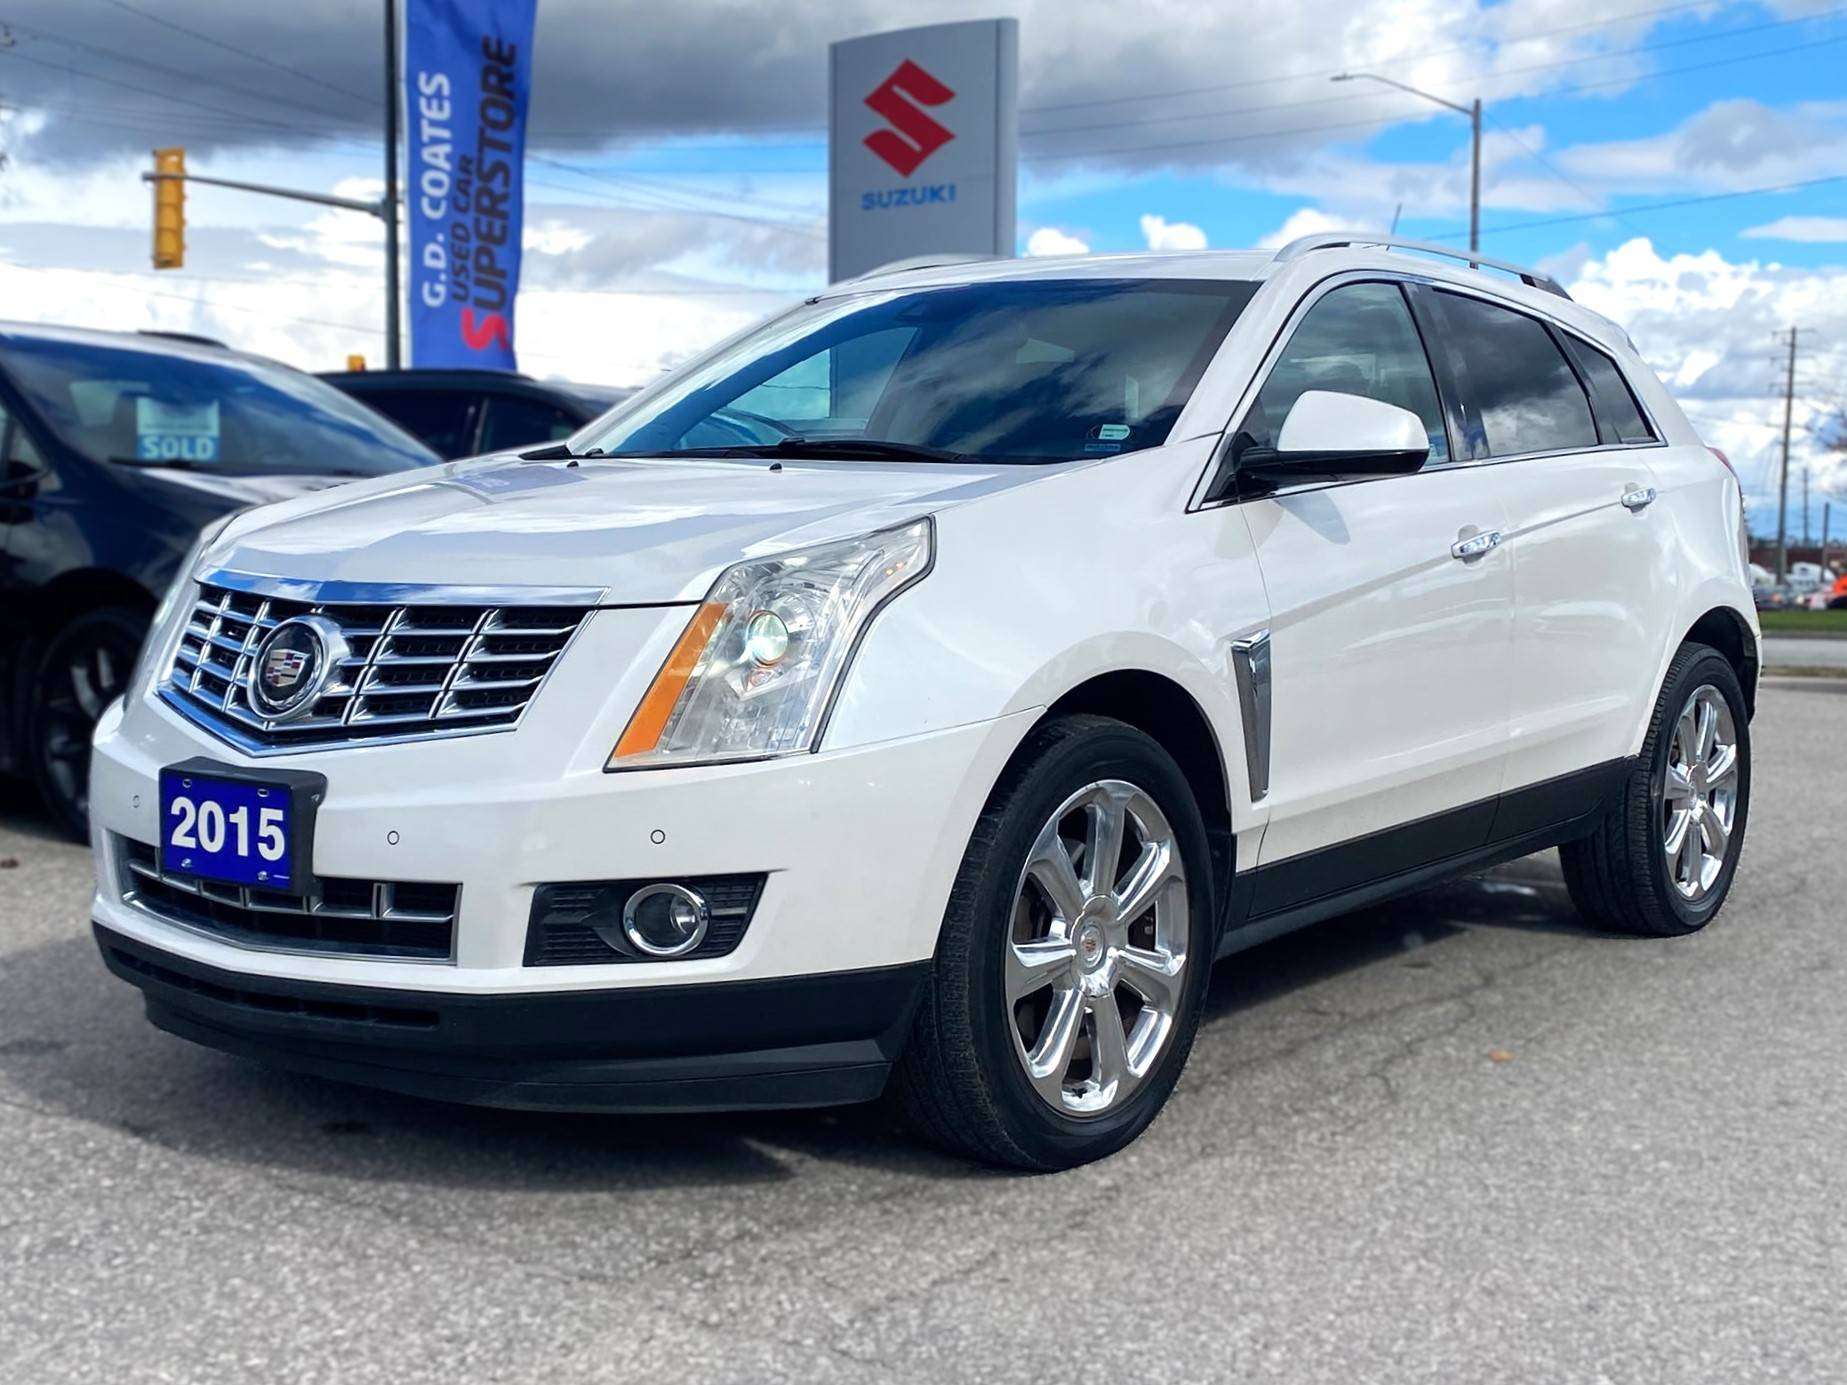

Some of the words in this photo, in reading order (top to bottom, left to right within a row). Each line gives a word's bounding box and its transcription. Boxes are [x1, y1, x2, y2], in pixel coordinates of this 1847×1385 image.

[419, 72, 452, 219] COATES
[452, 154, 475, 214] CAR
[461, 35, 516, 350] SUPERSTORE
[862, 185, 956, 210] SUZUKI
[422, 233, 447, 308] G.D.
[452, 222, 472, 303] USED
[143, 436, 215, 460] SOLD
[170, 796, 286, 862] 2015
